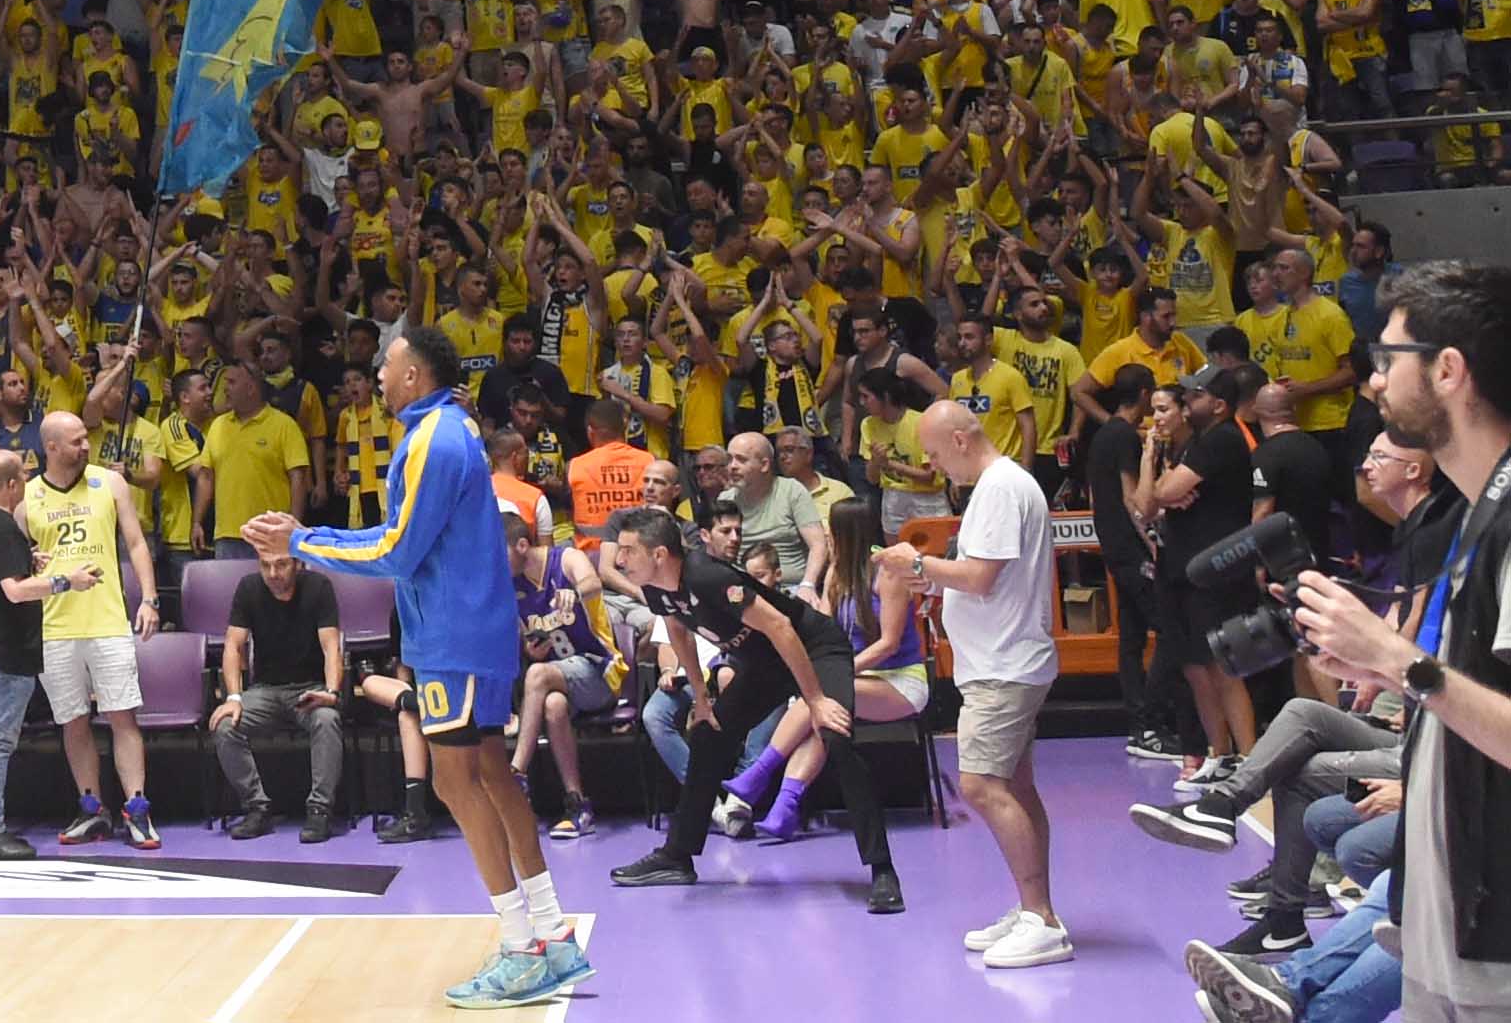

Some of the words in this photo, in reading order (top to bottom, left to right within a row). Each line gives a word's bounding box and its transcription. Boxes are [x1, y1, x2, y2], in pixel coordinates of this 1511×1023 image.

[461, 355, 496, 370] FOX
[57, 520, 87, 546] 25
[549, 629, 576, 659] 8
